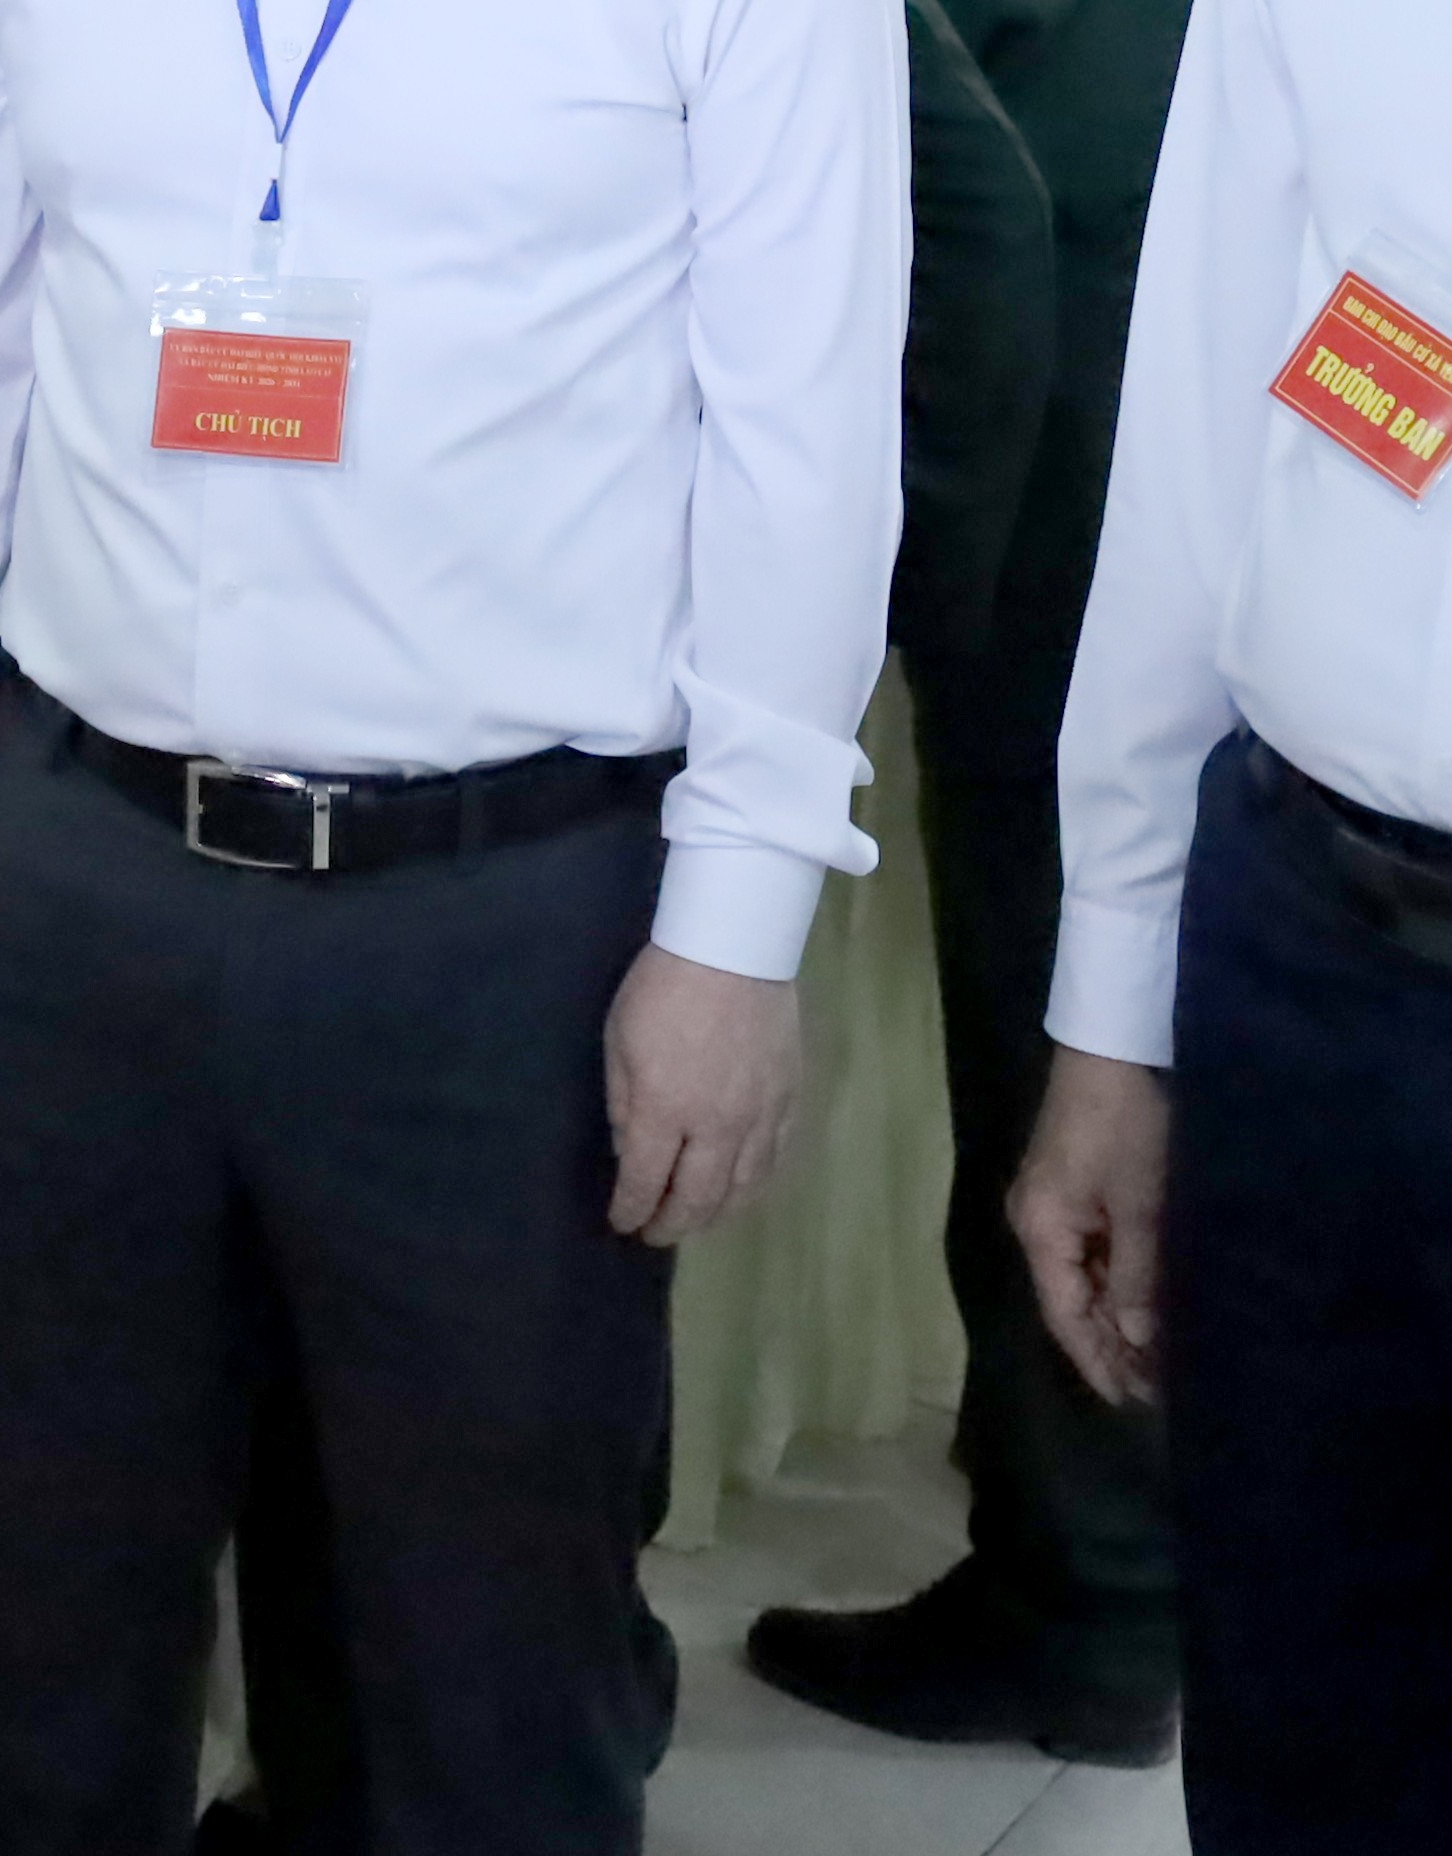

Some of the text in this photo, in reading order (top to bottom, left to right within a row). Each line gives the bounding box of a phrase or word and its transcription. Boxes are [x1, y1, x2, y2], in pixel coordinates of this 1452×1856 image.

[1342, 295, 1366, 319] BAN
[1305, 345, 1446, 461] TRƯỞNG BAN
[195, 409, 302, 442] CHỦ TỊCH
